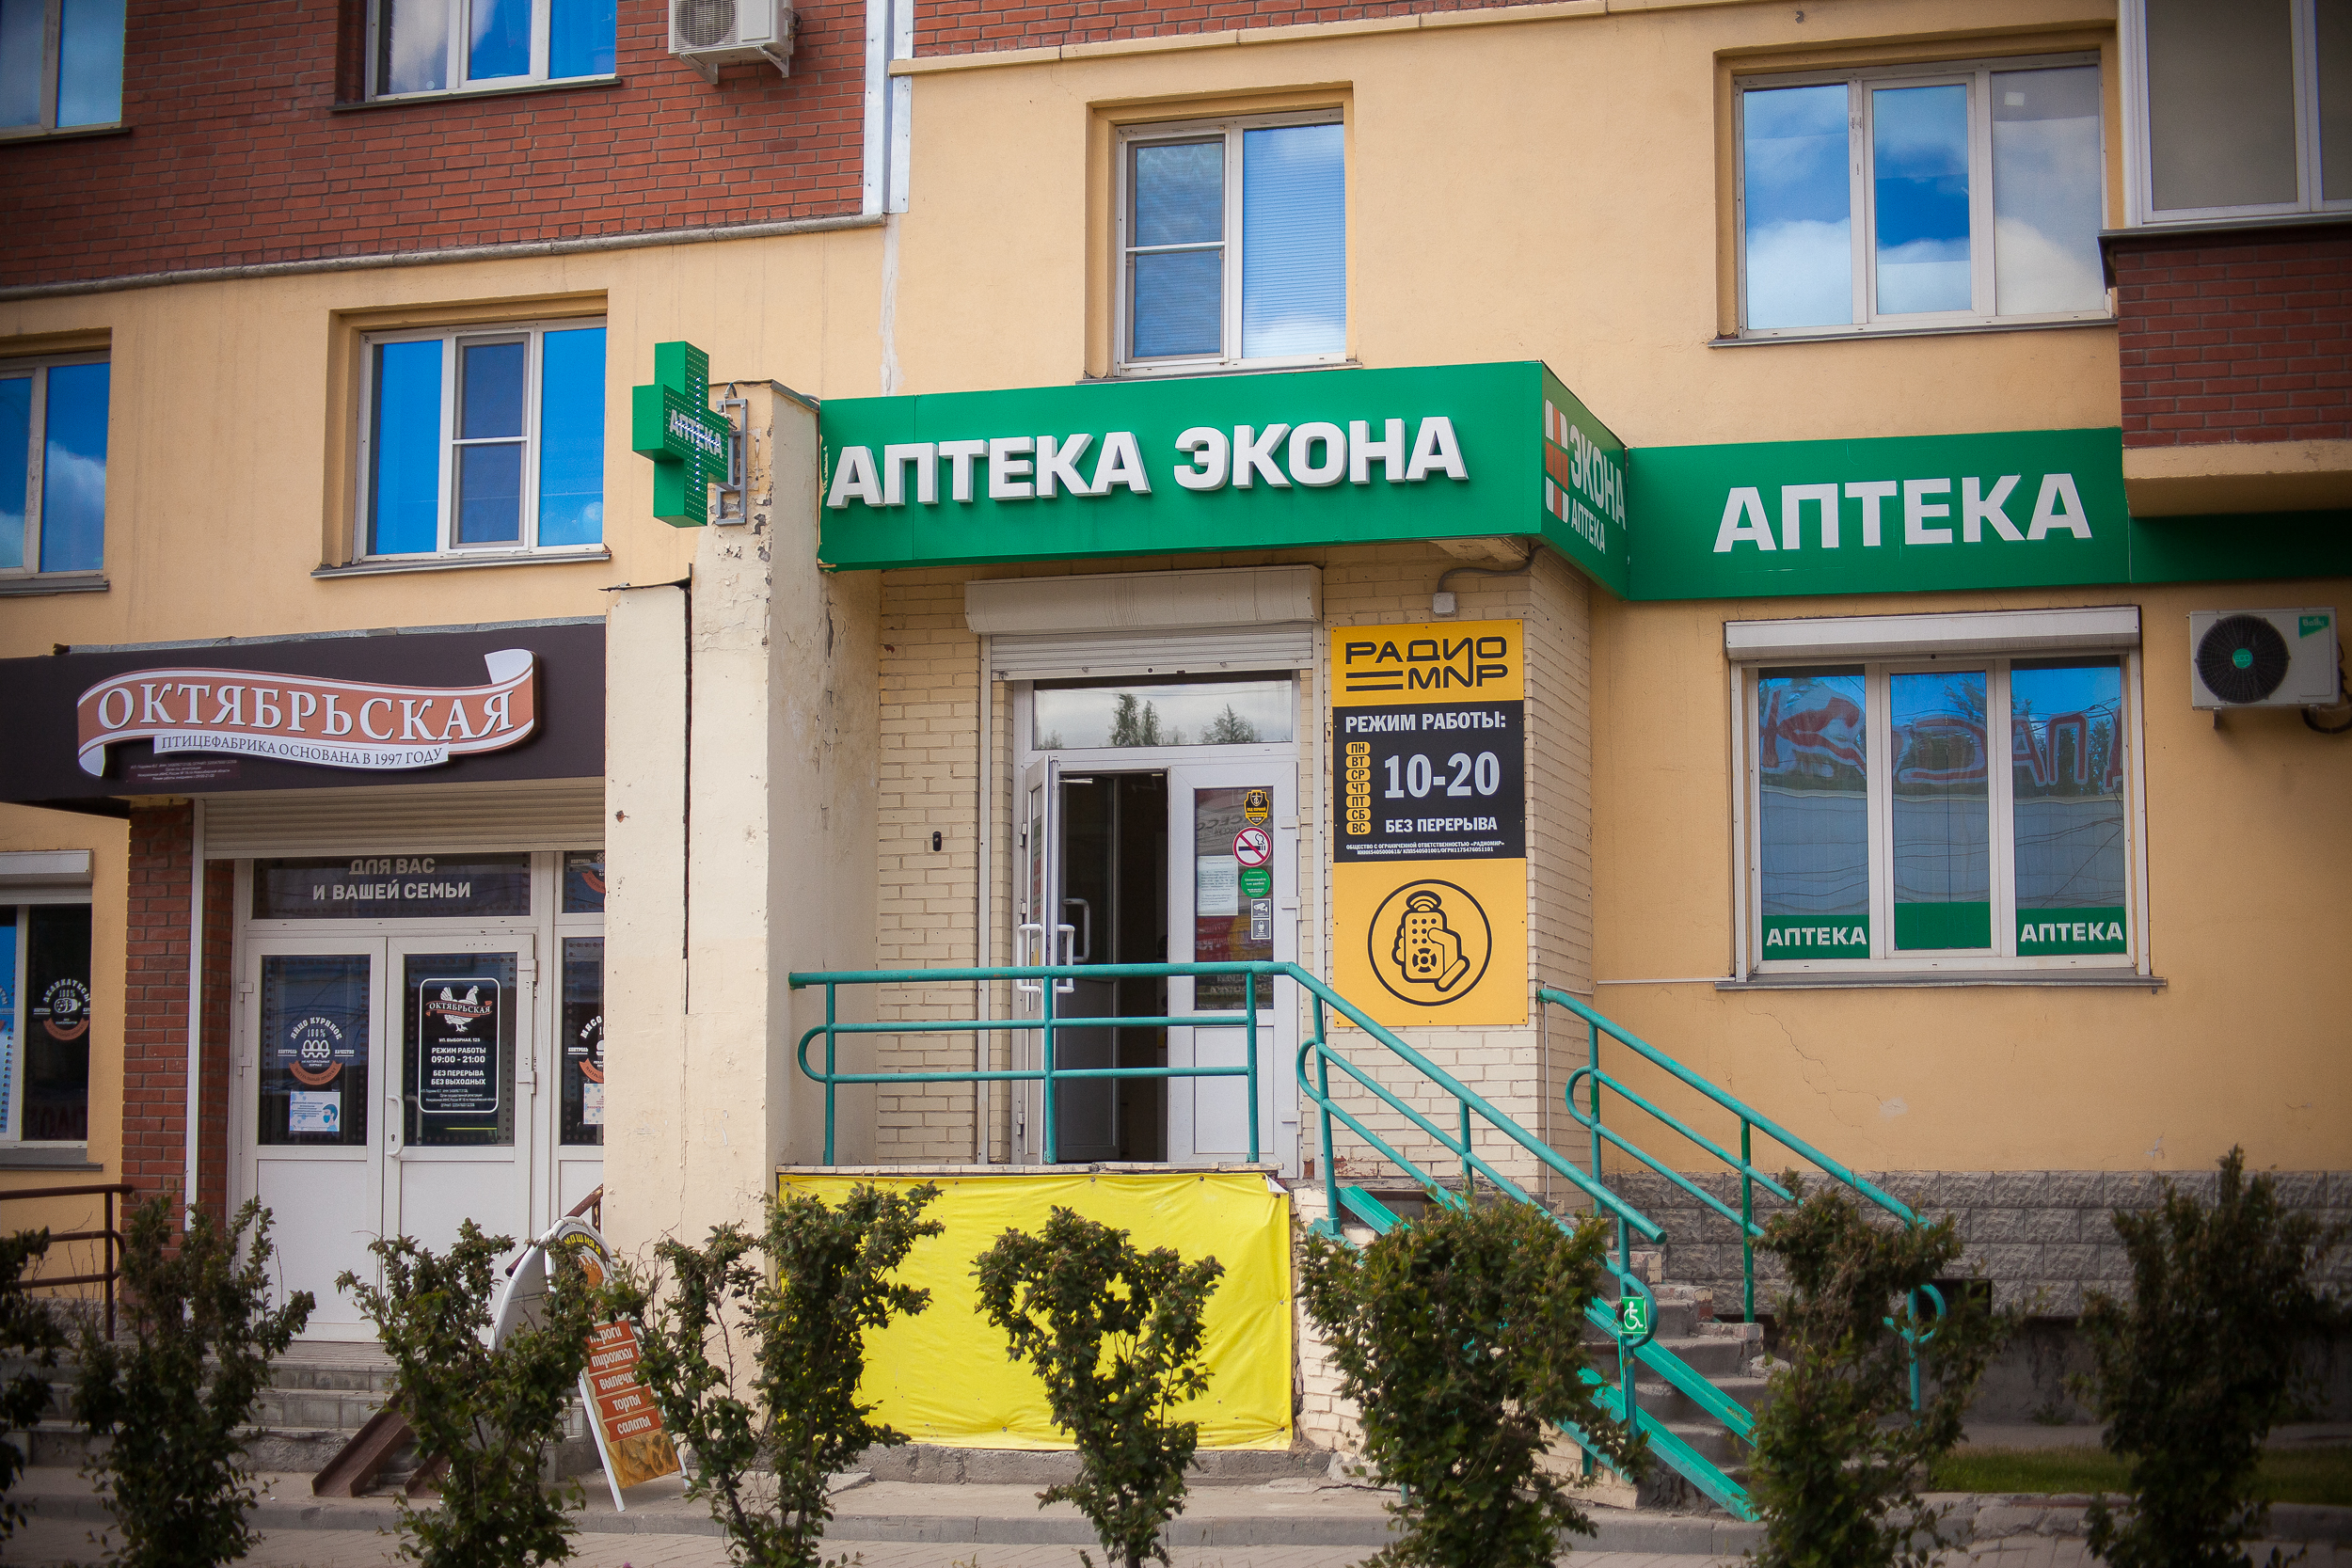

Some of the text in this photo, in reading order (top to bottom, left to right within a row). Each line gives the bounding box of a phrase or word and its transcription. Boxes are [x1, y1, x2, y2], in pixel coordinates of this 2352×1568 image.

[669, 408, 724, 459] АПТЕКА
[826, 416, 1470, 509] АПТЕКА ЭКОНА
[1569, 424, 1627, 531] ЭКОНА
[1712, 472, 2093, 553] АПТЕКА
[1570, 498, 1606, 555] АПТЕКА
[1346, 637, 1507, 665] РАДИО
[97, 683, 515, 741] ОКТЯБРЬСКАЯ
[1345, 710, 1506, 734] РЕЖИМ РАБОТЫ:
[161, 735, 443, 766] ПТИЦЕФАБРИКА ОСНОВАНА В 1997 ГОДУ
[1351, 743, 1365, 754] ПН
[1351, 756, 1365, 767] ВТ
[1351, 769, 1365, 781] СР
[1384, 751, 1501, 800] 10-20
[1351, 783, 1365, 794] ЧТ
[1352, 796, 1365, 806] ПТ
[1352, 809, 1366, 820] СБ
[1385, 816, 1498, 833] БЕЗ ПЕРЕРЫВА
[1352, 822, 1366, 833] ВС
[349, 857, 436, 875] ДЛЯ ВАС
[312, 879, 470, 900] И ВАШЕЙ СЕМЬИ
[1766, 926, 1867, 946] АПТЕКА
[2019, 921, 2124, 942] АПТЕКА
[429, 1002, 490, 1014] ОКТЯБРЬСКАЯ
[307, 1028, 326, 1037] 100%
[310, 1016, 342, 1040] КУРИНОЕ
[564, 1233, 601, 1256] машняя
[590, 1347, 634, 1370] пирожки
[598, 1370, 638, 1390] выпечк
[612, 1393, 642, 1413] торты
[616, 1415, 652, 1434] салаты
